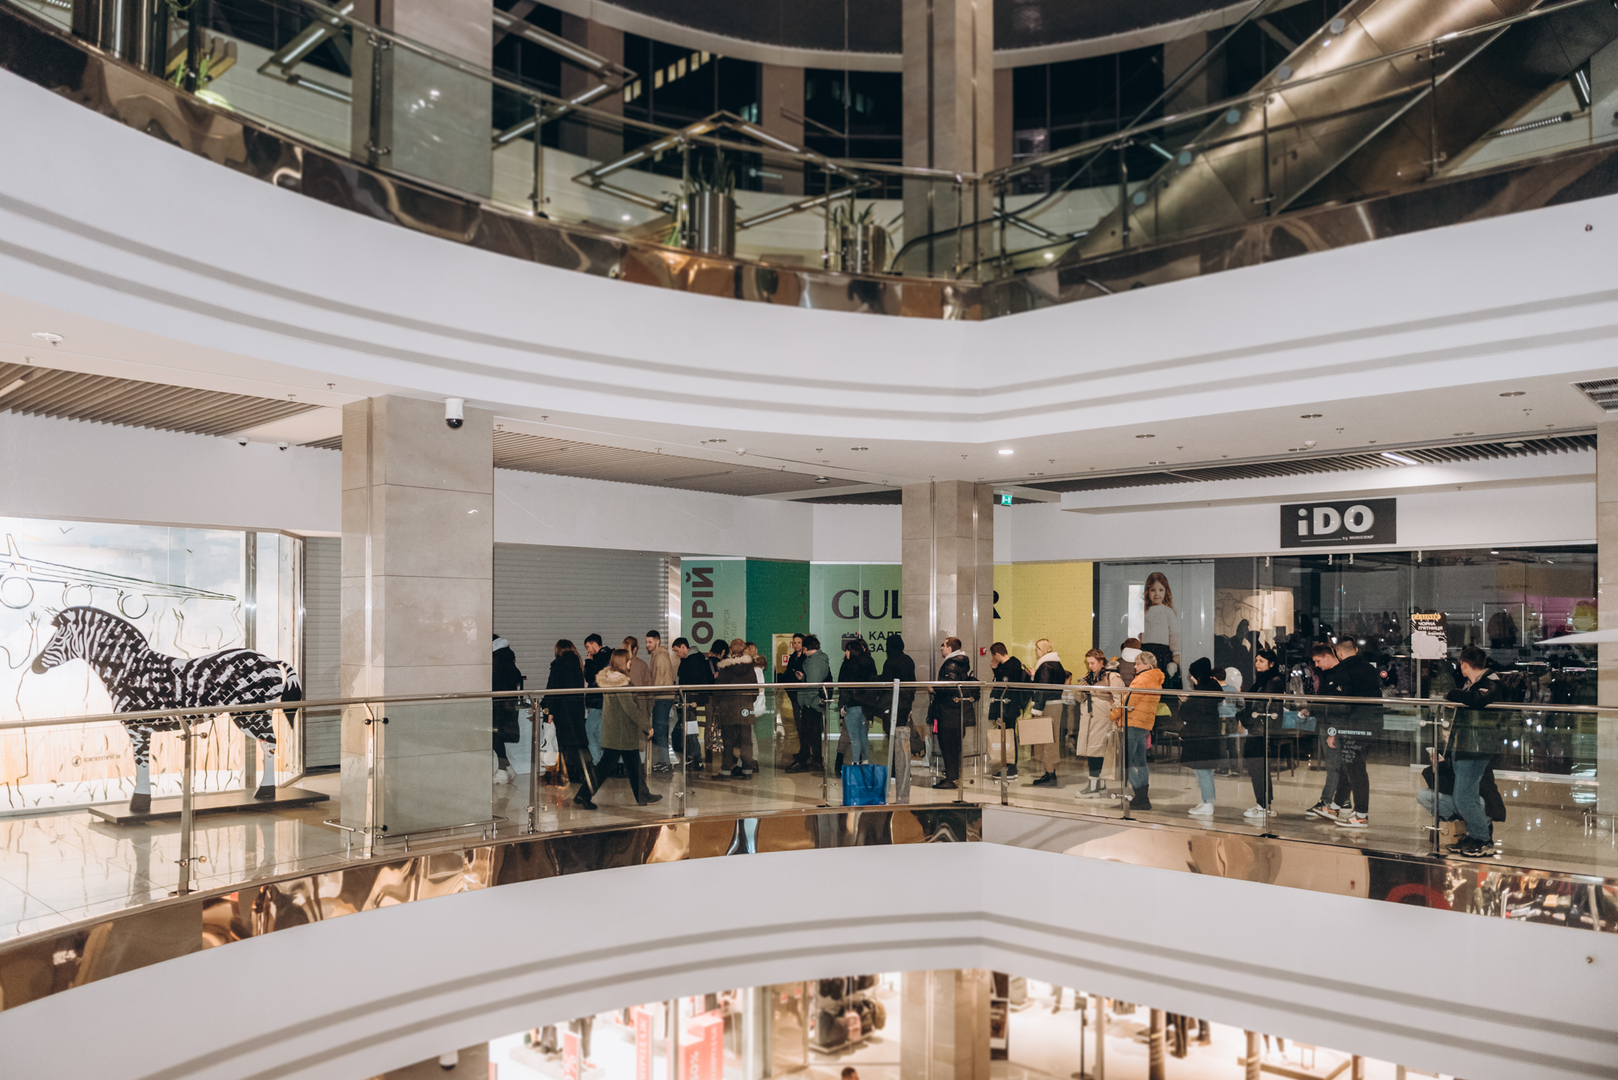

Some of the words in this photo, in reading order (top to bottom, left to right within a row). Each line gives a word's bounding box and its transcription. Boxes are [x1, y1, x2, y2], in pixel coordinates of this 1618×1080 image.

[1298, 504, 1375, 536] iDO
[685, 567, 714, 645] ОРІЙ
[869, 643, 886, 652] ЗА
